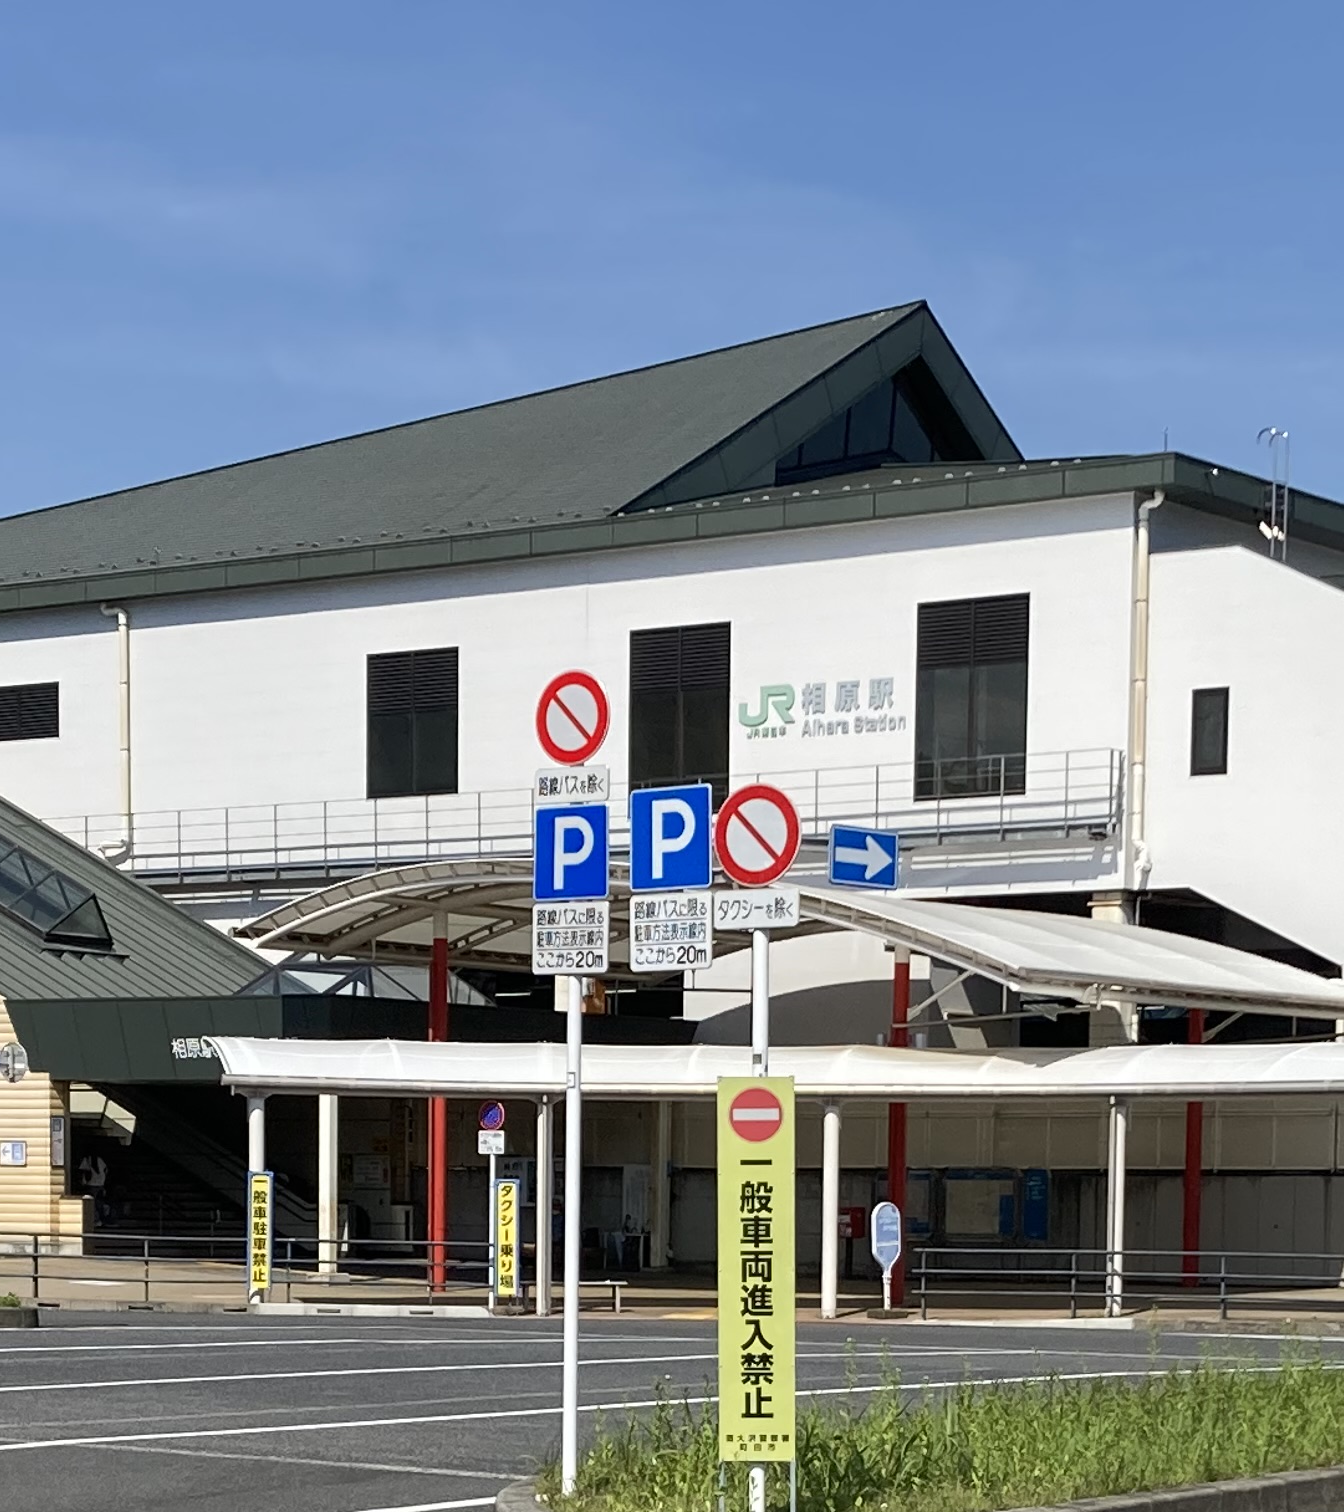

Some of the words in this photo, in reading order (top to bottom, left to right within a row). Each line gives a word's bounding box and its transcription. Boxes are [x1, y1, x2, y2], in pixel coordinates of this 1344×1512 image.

[801, 677, 894, 715] 相原駅
[801, 716, 849, 738] Aihara
[853, 714, 907, 734] Station
[538, 773, 605, 796] 路線バスを除く
[652, 798, 696, 880] P
[554, 815, 595, 891] P
[537, 907, 605, 925] 路線バスに限る
[635, 898, 707, 919] 路線バスに限る
[718, 897, 793, 920] タクシーを除く
[537, 950, 603, 968] ここから20m
[636, 945, 707, 965] ここから20m
[252, 1179, 268, 1283] 一般車駐車禁止
[500, 1185, 514, 1289] タクシー乗り場
[740, 1159, 774, 1419] 一般車両進入禁止
